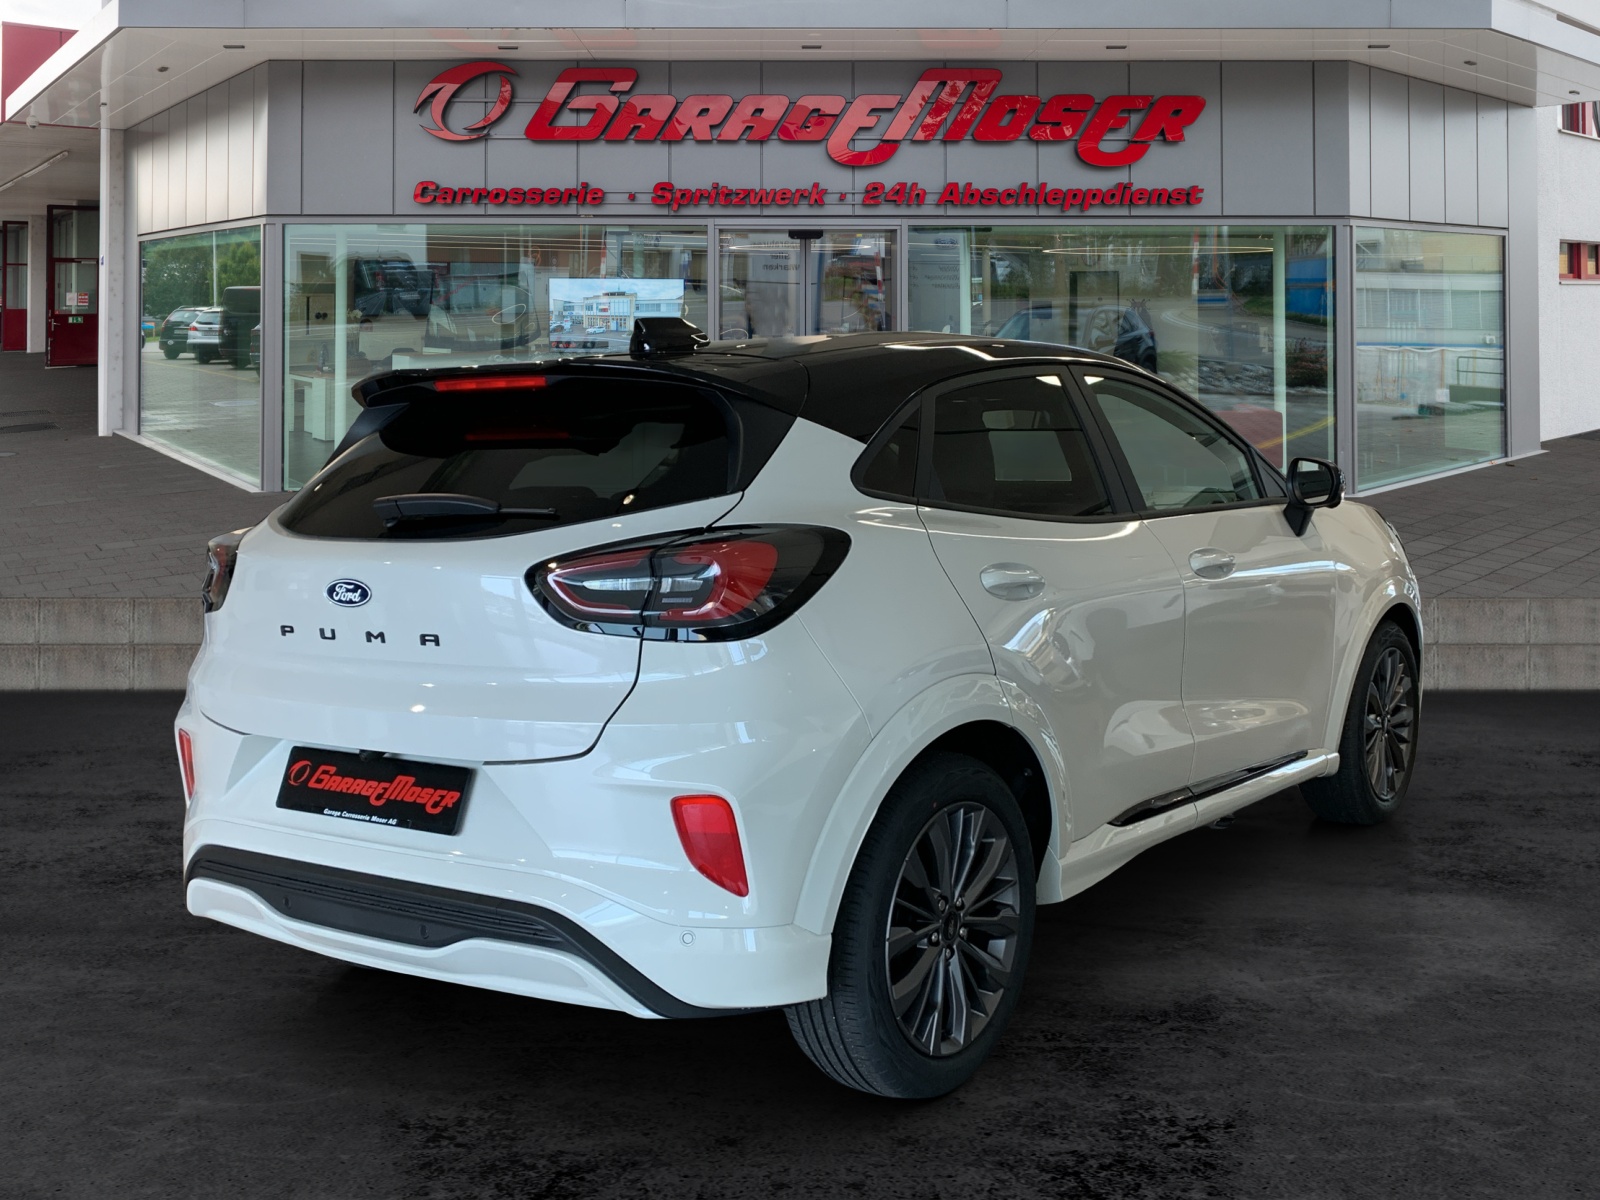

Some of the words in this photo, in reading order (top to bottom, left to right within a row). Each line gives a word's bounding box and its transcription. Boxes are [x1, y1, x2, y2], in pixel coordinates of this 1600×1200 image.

[413, 180, 604, 205] Carrosserie
[651, 181, 827, 211] Spritzwerk
[862, 181, 927, 205] 24h
[937, 181, 1204, 211] Abschleppdienst
[333, 583, 361, 602] Ford
[280, 624, 440, 647] PUMA
[323, 808, 341, 816] Garage
[341, 811, 370, 820] Carrosserie
[370, 815, 388, 823] Moser
